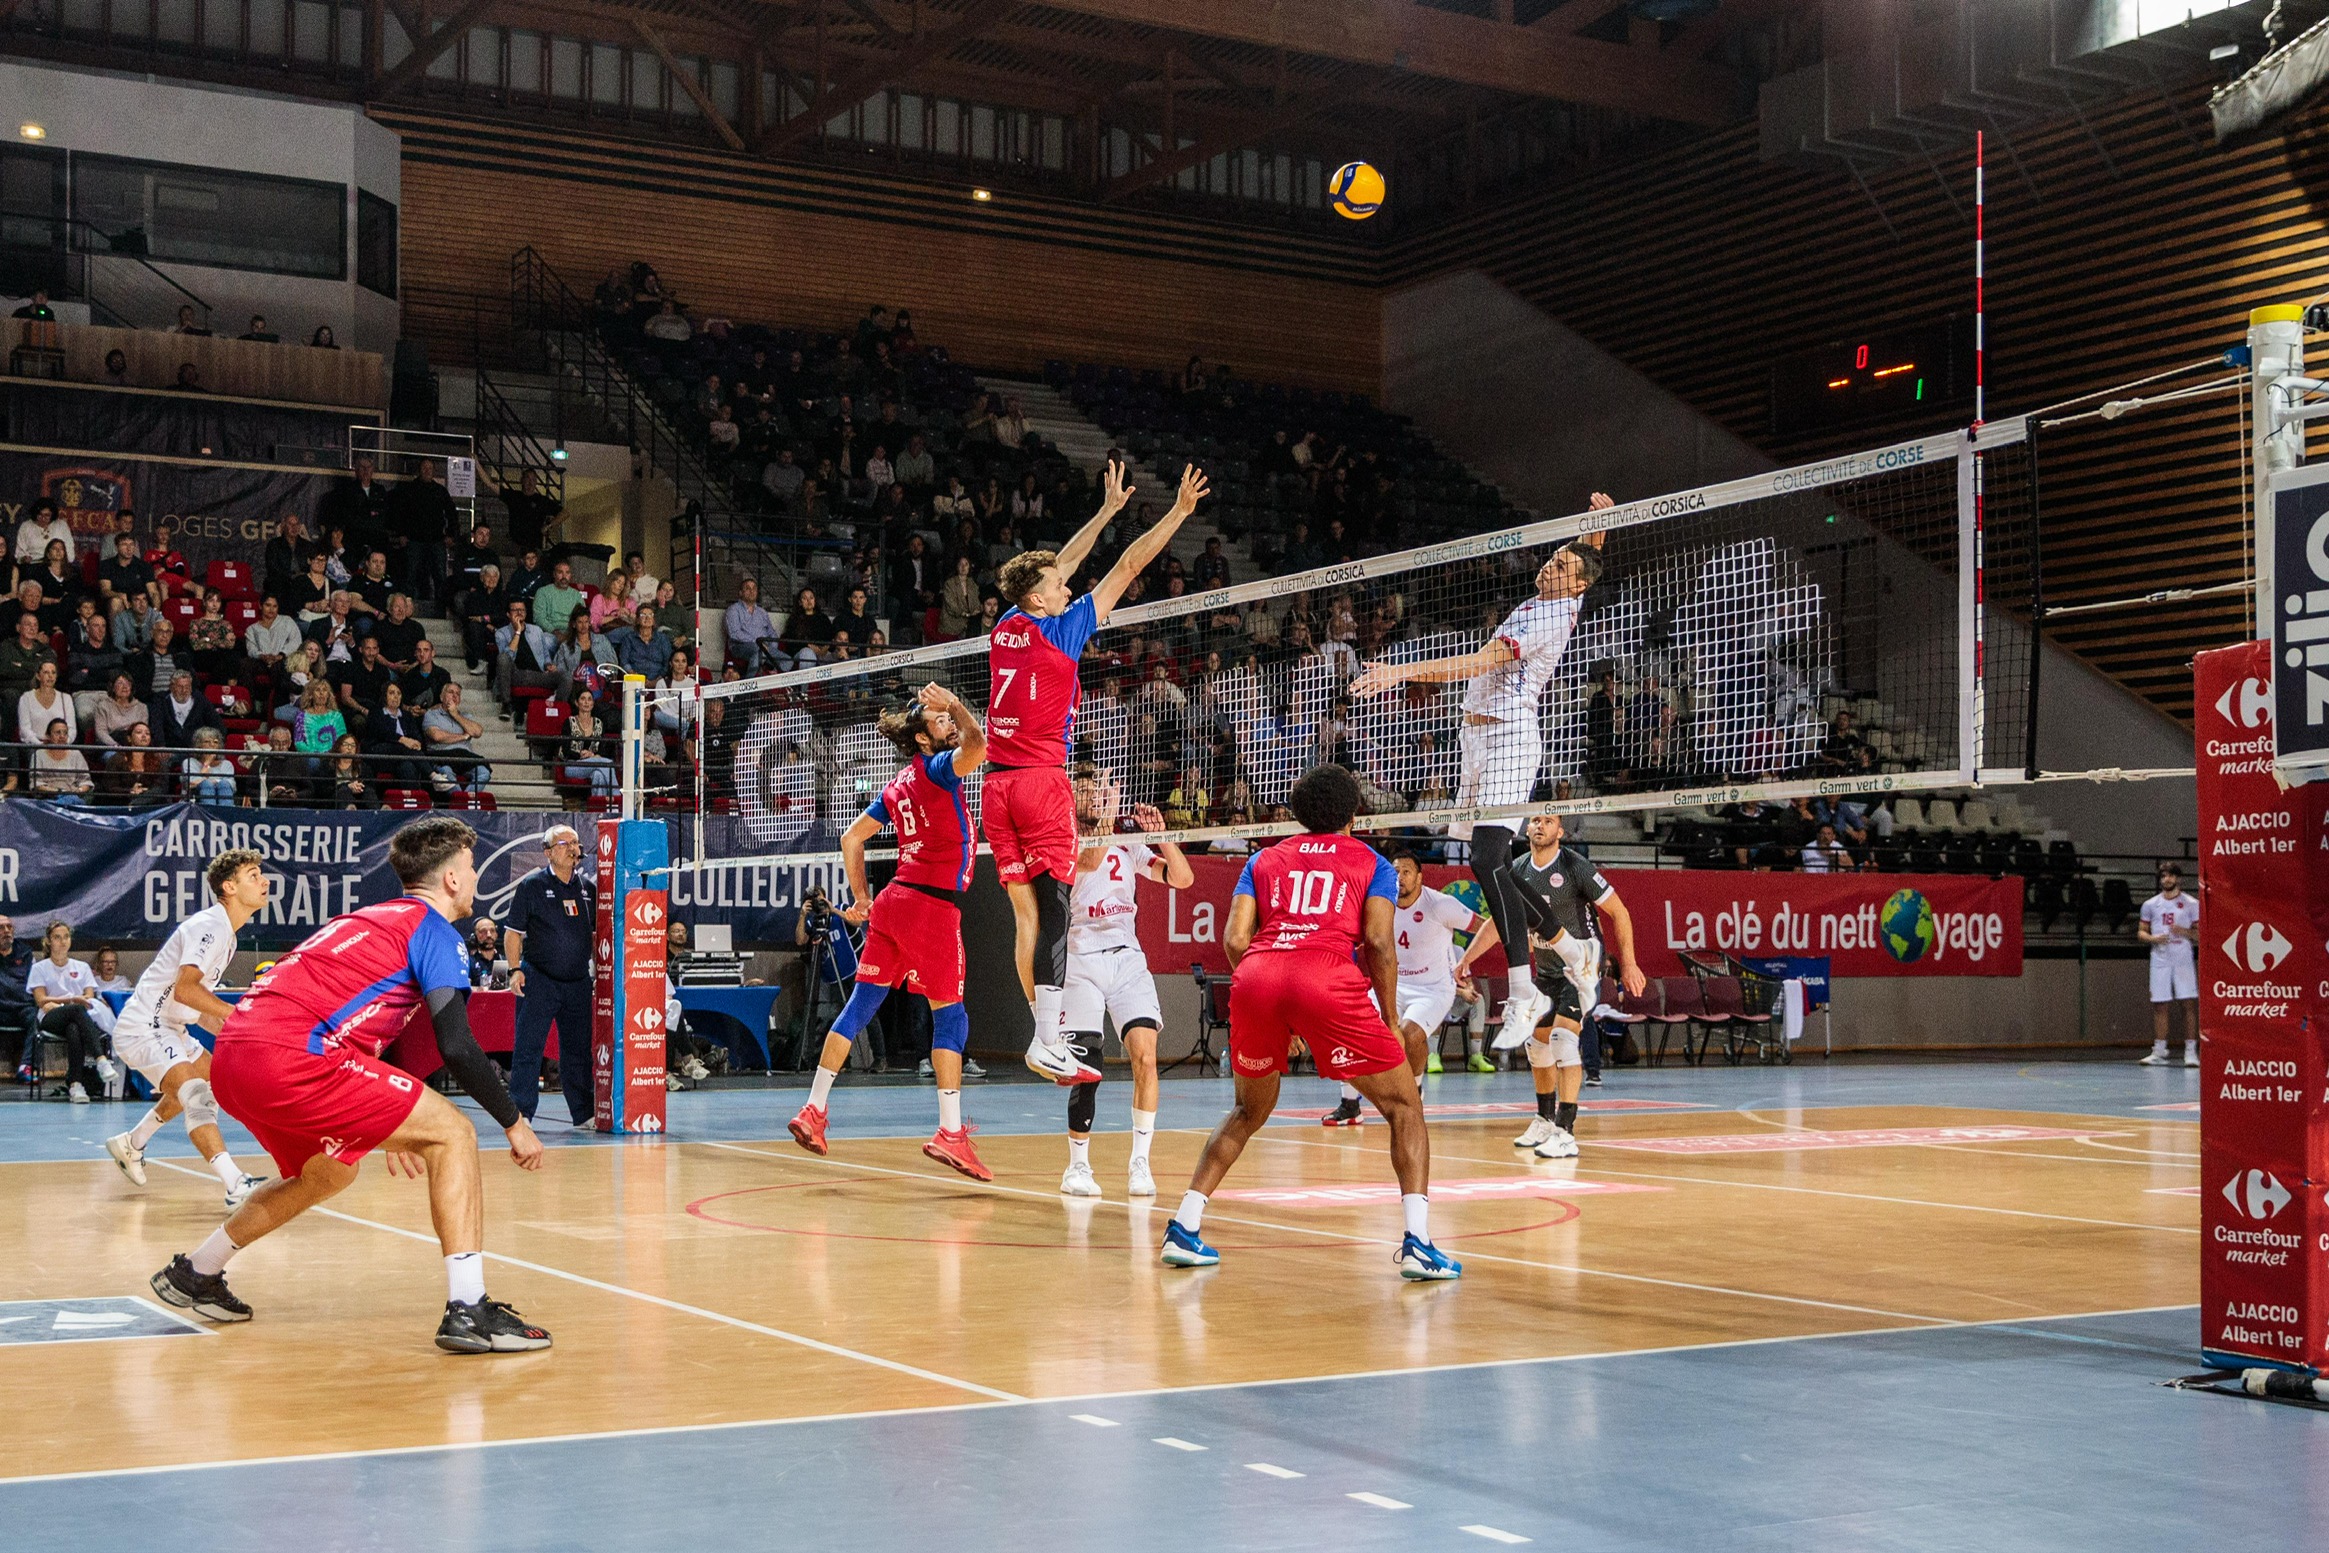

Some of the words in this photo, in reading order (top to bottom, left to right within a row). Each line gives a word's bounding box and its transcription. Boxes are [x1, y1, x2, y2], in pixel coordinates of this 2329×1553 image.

[1773, 457, 1858, 492] COLLECTIVITÉ
[1876, 445, 1924, 470] CORSE
[1652, 492, 1706, 518] CORSICA
[1414, 540, 1474, 567] COLLECTIVITÉ
[1488, 531, 1522, 551] CORSE
[1325, 564, 1365, 583] CORSICA
[1204, 592, 1230, 608] CORSE
[890, 653, 916, 668] CORSICA
[816, 668, 832, 680] CORSE
[994, 668, 1018, 710] 7
[2206, 736, 2274, 757] Carrefo
[2219, 757, 2274, 776] marke
[1819, 781, 1852, 794] Gamm
[1856, 778, 1878, 792] vert
[1674, 792, 1702, 806] Gamm
[1706, 790, 1726, 803] vert
[1544, 803, 1570, 815] Gamm
[1574, 800, 1591, 812] vert
[898, 798, 917, 836] 6
[1353, 818, 1362, 829] ert
[1428, 812, 1452, 824] Gamm
[1454, 810, 1470, 822] vert
[2214, 811, 2291, 832] AJACCIO
[145, 818, 362, 863] CARROSSERIE
[1164, 833, 1176, 842] vert
[1230, 827, 1250, 838] Gamm
[1252, 826, 1265, 836] vert
[1298, 843, 1336, 854] BALA
[2212, 838, 2266, 856] Albert
[2270, 836, 2296, 854] 1er
[1066, 860, 1076, 876] 7
[1106, 854, 1123, 882] 2
[672, 856, 850, 908] COLLECTOR
[144, 870, 363, 925] GERALE
[1288, 870, 1334, 916] 10
[1168, 888, 1216, 944] La
[630, 928, 666, 936] Carrefour
[1665, 900, 1706, 950] La
[1716, 900, 1762, 950] clé
[1770, 900, 1810, 950] du
[635, 936, 662, 944] market
[1398, 930, 1410, 950] 4
[633, 960, 664, 968] AJACCIO
[632, 970, 654, 978] Albert
[958, 980, 964, 996] 6
[2214, 980, 2302, 999] Carrefour
[1058, 1011, 1066, 1026] 2
[2224, 1002, 2288, 1018] market
[630, 1032, 666, 1041] Carrefour
[634, 1041, 661, 1049] market
[164, 1046, 178, 1060] 2
[633, 1066, 664, 1074] AJACCIO
[2224, 1060, 2297, 1077] AJACCIO
[388, 1074, 412, 1092] 8
[631, 1077, 654, 1086] Albert
[655, 1077, 665, 1085] 1er
[2220, 1082, 2272, 1101] Albert
[2276, 1084, 2302, 1102] 1er
[2214, 1225, 2302, 1248] Carrefour
[2226, 1249, 2288, 1267] market
[2226, 1301, 2298, 1324] AJACCIO
[2220, 1324, 2273, 1346] Albert
[2277, 1330, 2303, 1348] 1er
